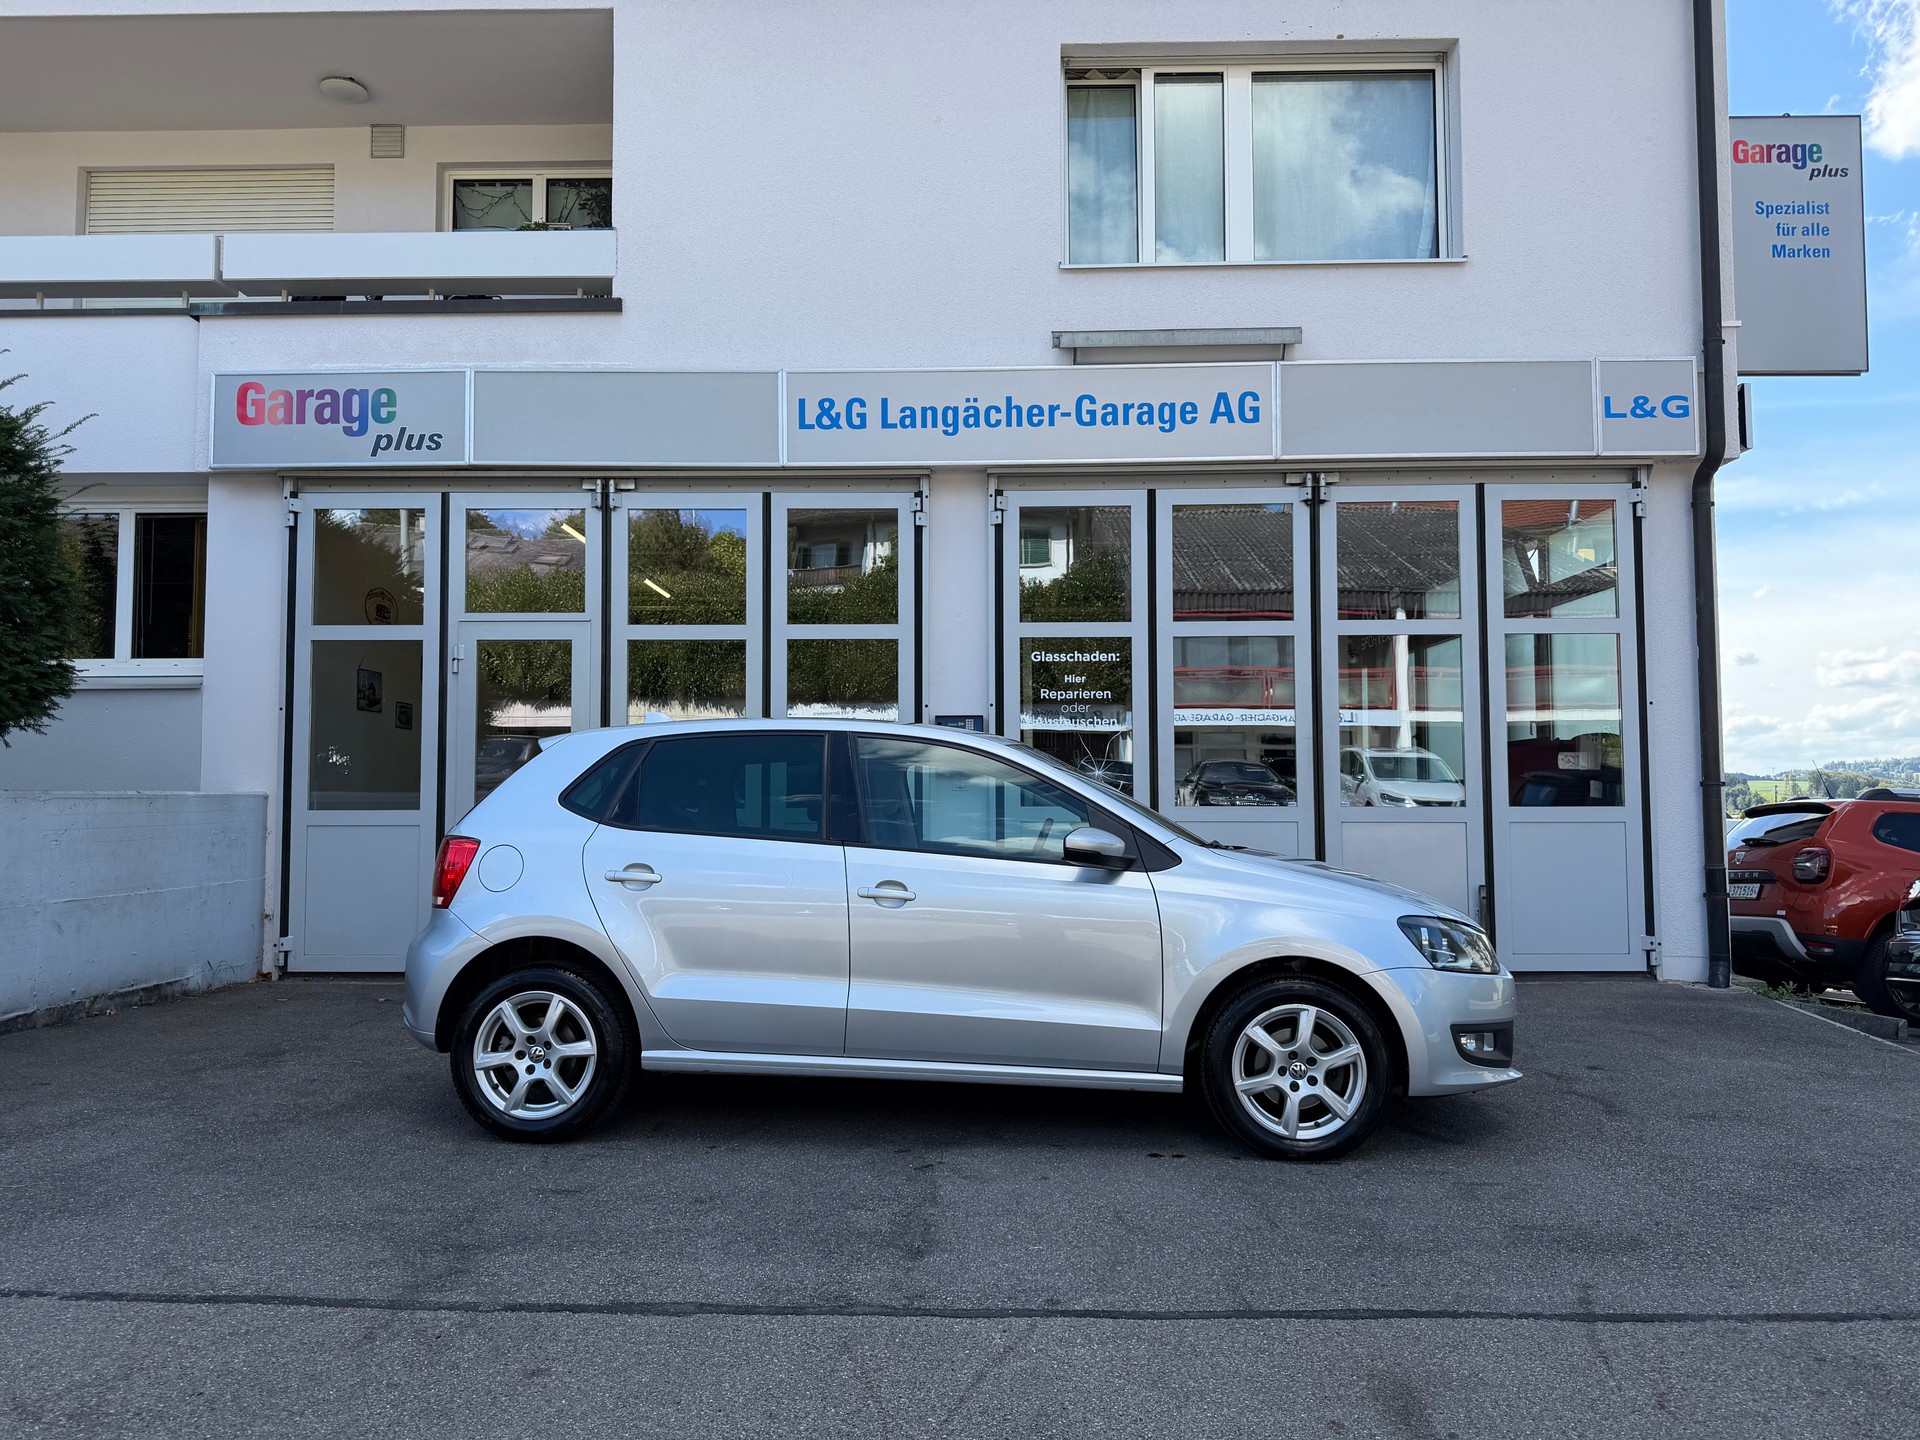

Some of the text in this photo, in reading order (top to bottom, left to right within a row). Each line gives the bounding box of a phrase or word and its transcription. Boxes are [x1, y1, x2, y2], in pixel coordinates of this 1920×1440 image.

[1732, 139, 1822, 170] Garage
[1809, 164, 1849, 181] plus
[1755, 200, 1830, 218] Spezialist
[1776, 223, 1830, 237] für alle
[1771, 244, 1831, 259] Marken
[236, 381, 398, 437] Garage
[798, 391, 1261, 437] L&G Langächer-Garage AG
[1603, 395, 1690, 419] L&G
[369, 426, 444, 457] plus
[1031, 651, 1120, 662] Glasschaden:
[1064, 674, 1086, 683] Hier
[1040, 688, 1112, 701] Reparieren
[1060, 702, 1091, 713] oder
